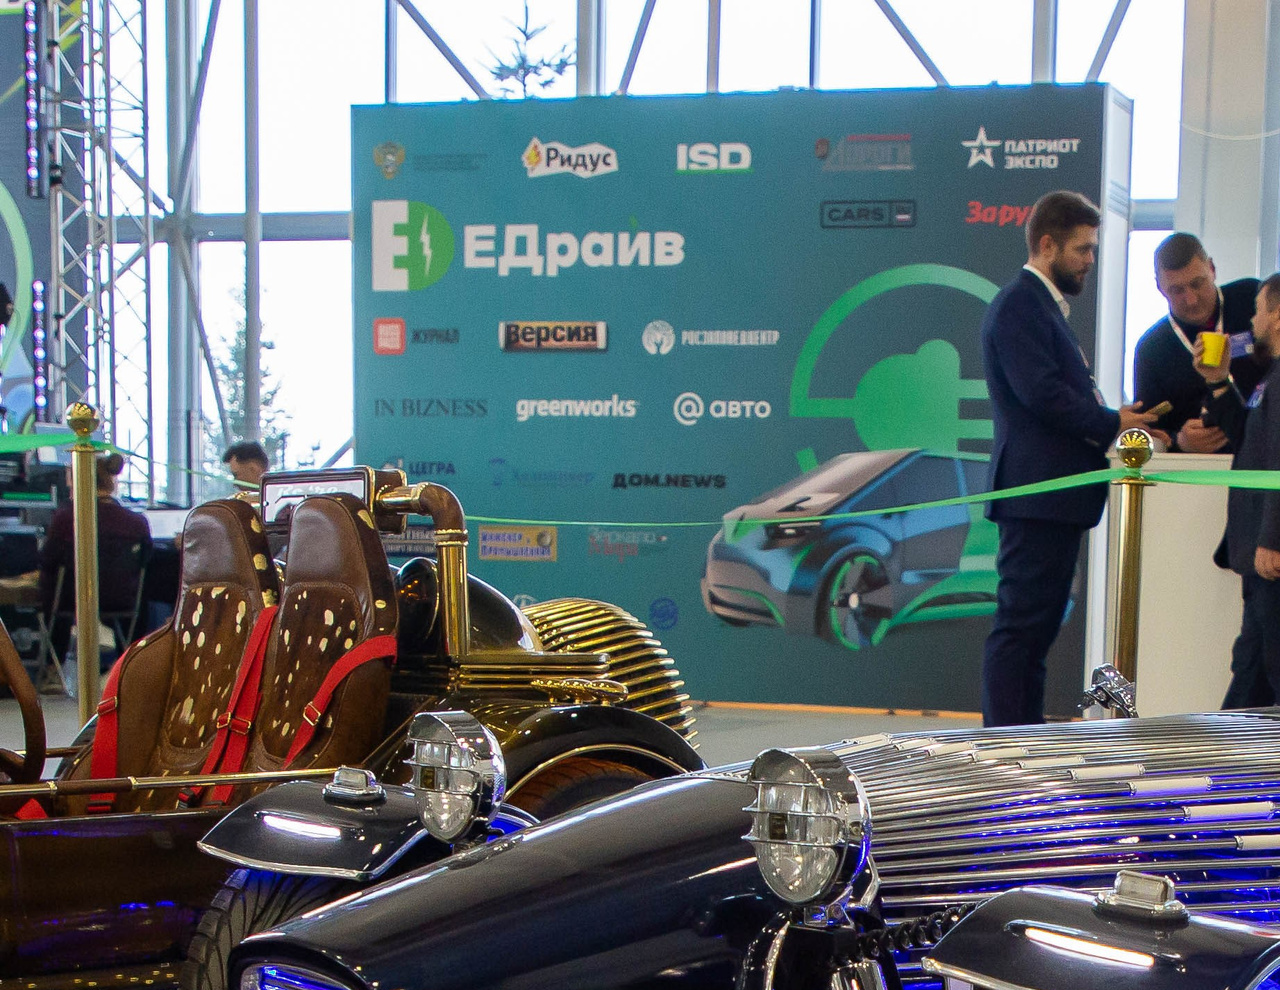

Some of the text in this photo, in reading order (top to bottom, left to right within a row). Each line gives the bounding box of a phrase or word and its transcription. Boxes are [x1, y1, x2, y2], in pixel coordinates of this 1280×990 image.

[1004, 138, 1081, 154] ПАТРИОТ
[546, 147, 612, 169] Ридус
[676, 142, 752, 170] ISD
[1004, 155, 1059, 170] ЭКСПО
[827, 204, 885, 223] CARS
[505, 323, 598, 346] Версия
[374, 399, 488, 418] IN BIZNESS
[515, 394, 637, 421] greenworks
[709, 400, 772, 419] авто
[612, 472, 727, 490] ДОМ.NEWS
